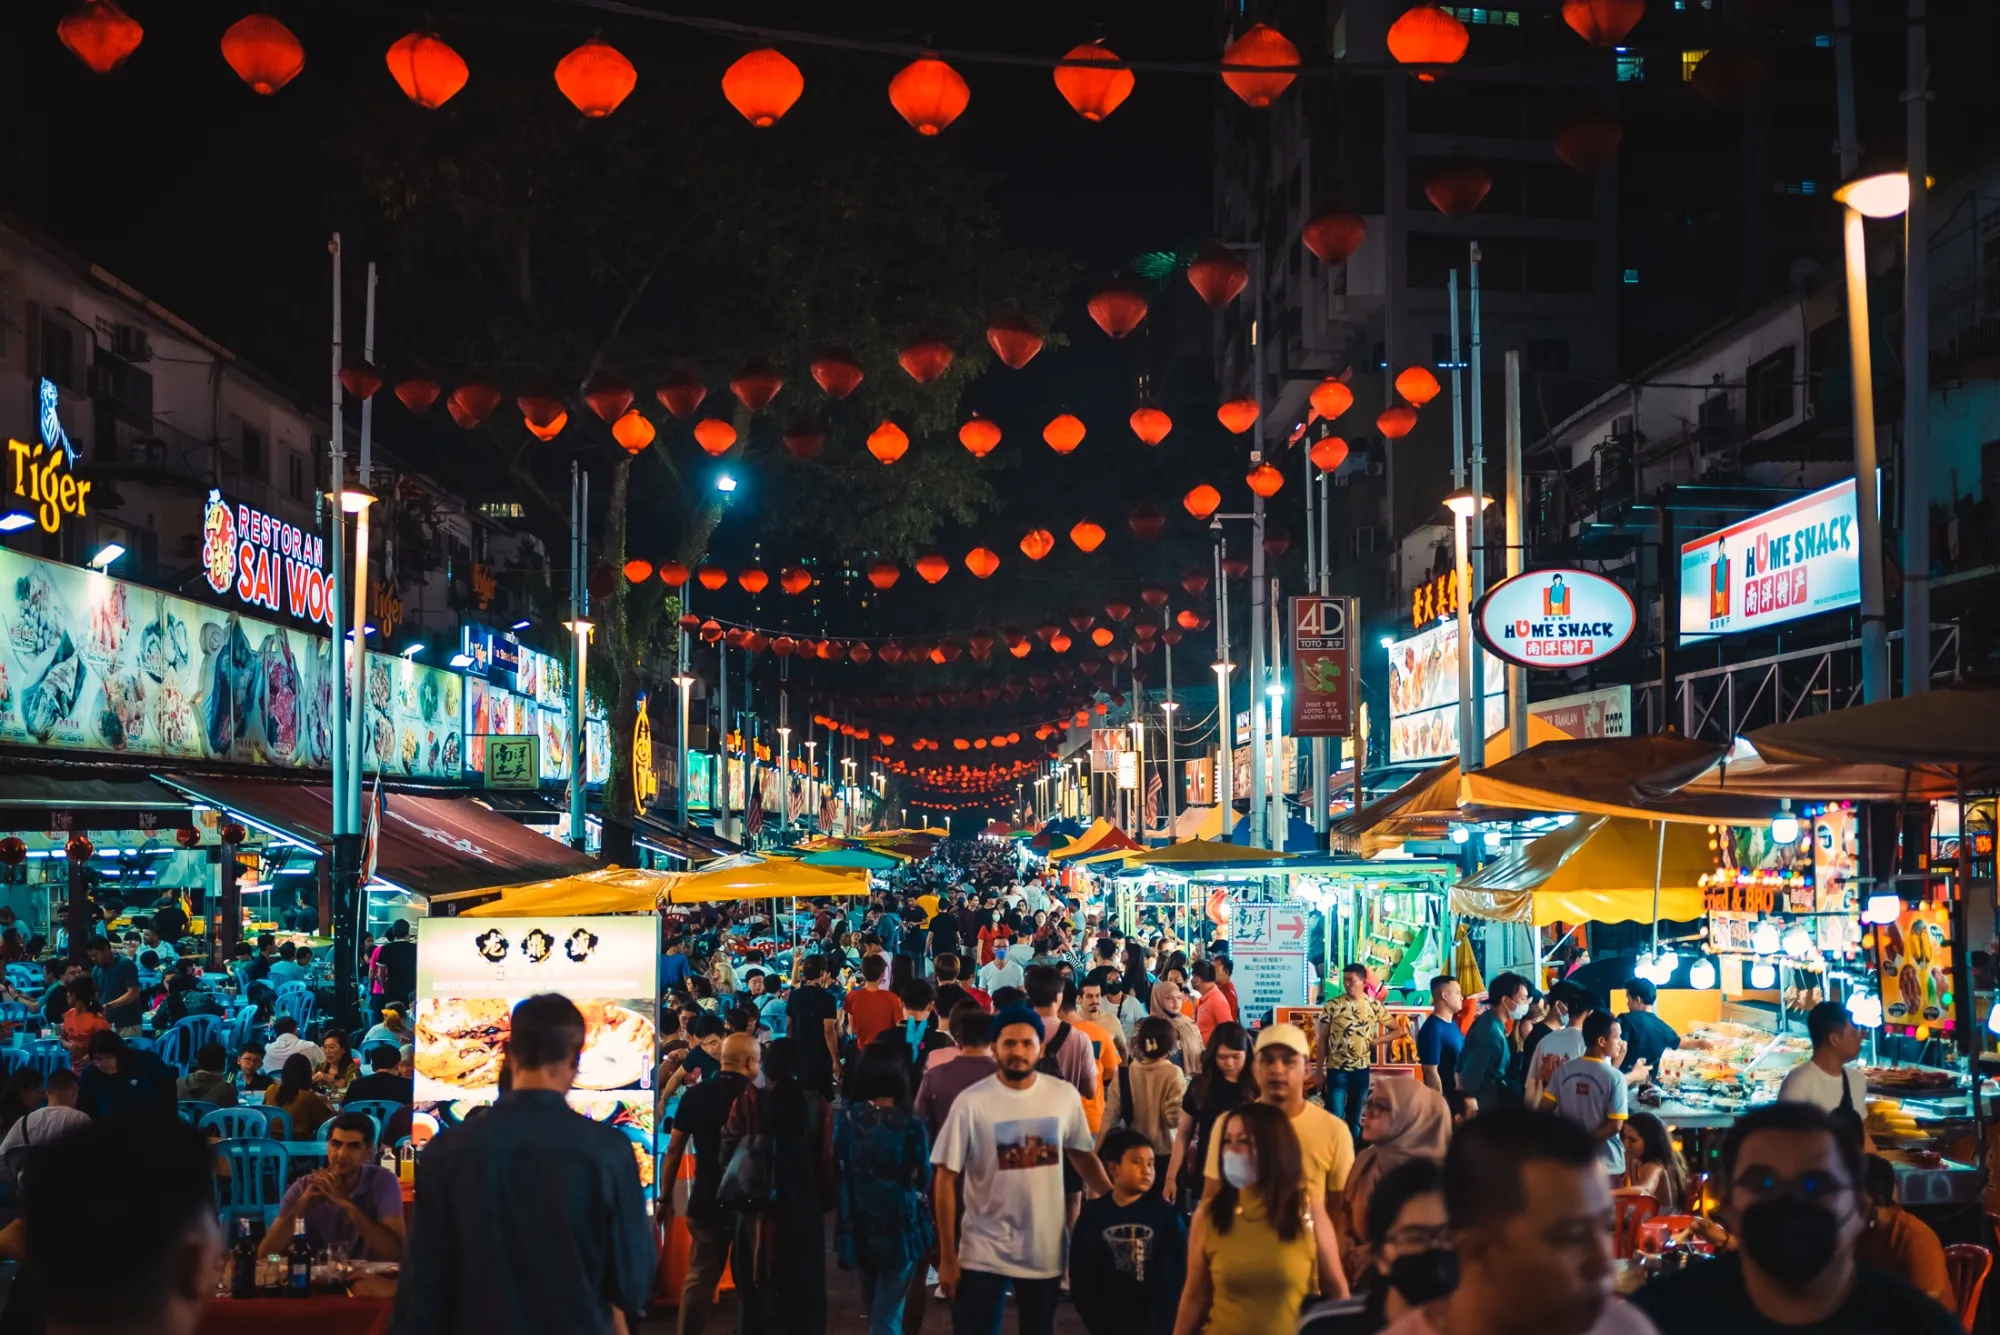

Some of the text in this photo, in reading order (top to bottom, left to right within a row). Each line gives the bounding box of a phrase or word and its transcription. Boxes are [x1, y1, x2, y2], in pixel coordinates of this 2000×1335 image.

[8, 438, 91, 534] Tiger
[239, 504, 322, 568] RESTORAN
[1745, 514, 1852, 578] HOME SNACK
[238, 541, 280, 611] SAI
[1745, 566, 1807, 617] 南洋特产
[1297, 602, 1345, 635] 4D
[1300, 640, 1321, 648] TOTO
[1505, 620, 1614, 638] HOME SNACK
[1526, 640, 1592, 656] 南洋特产
